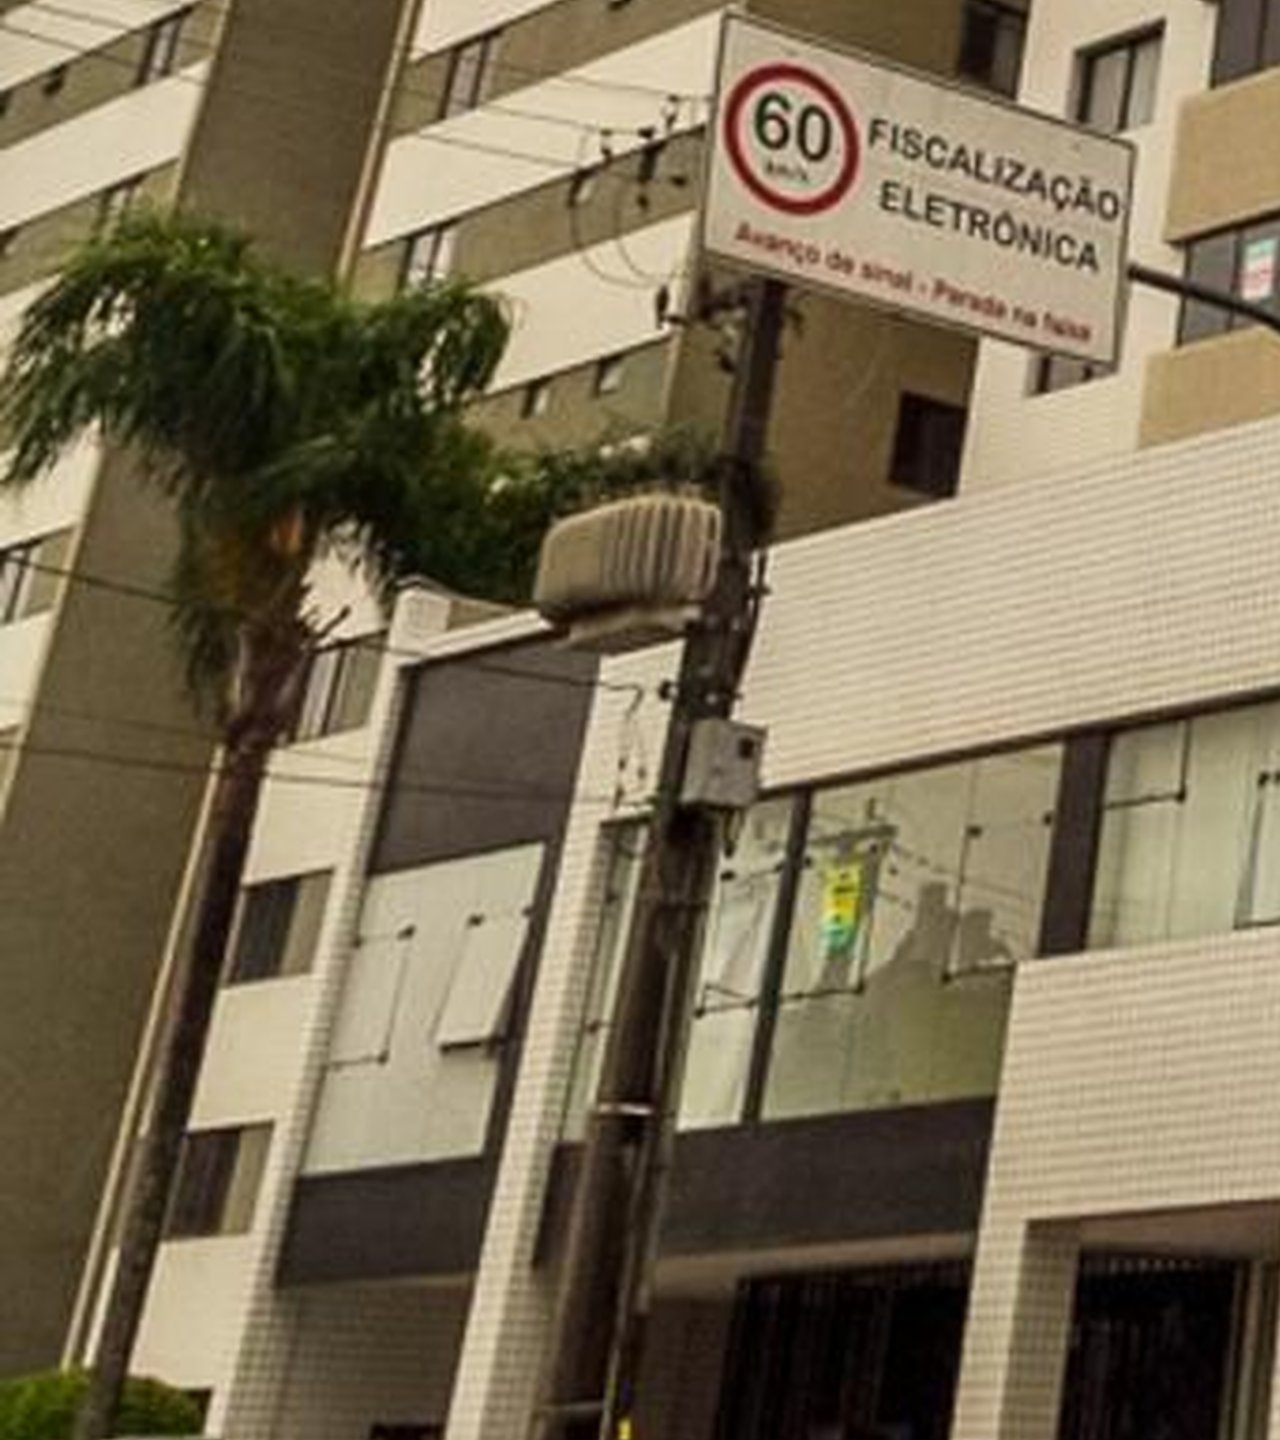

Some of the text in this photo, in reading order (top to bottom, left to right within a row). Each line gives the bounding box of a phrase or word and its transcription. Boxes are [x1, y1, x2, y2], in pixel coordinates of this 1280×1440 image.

[755, 91, 832, 163] 60
[867, 117, 1121, 221] FISCALIZAÇÃO
[734, 221, 821, 266] Avanço
[879, 180, 1100, 273] ELETRÔNICA
